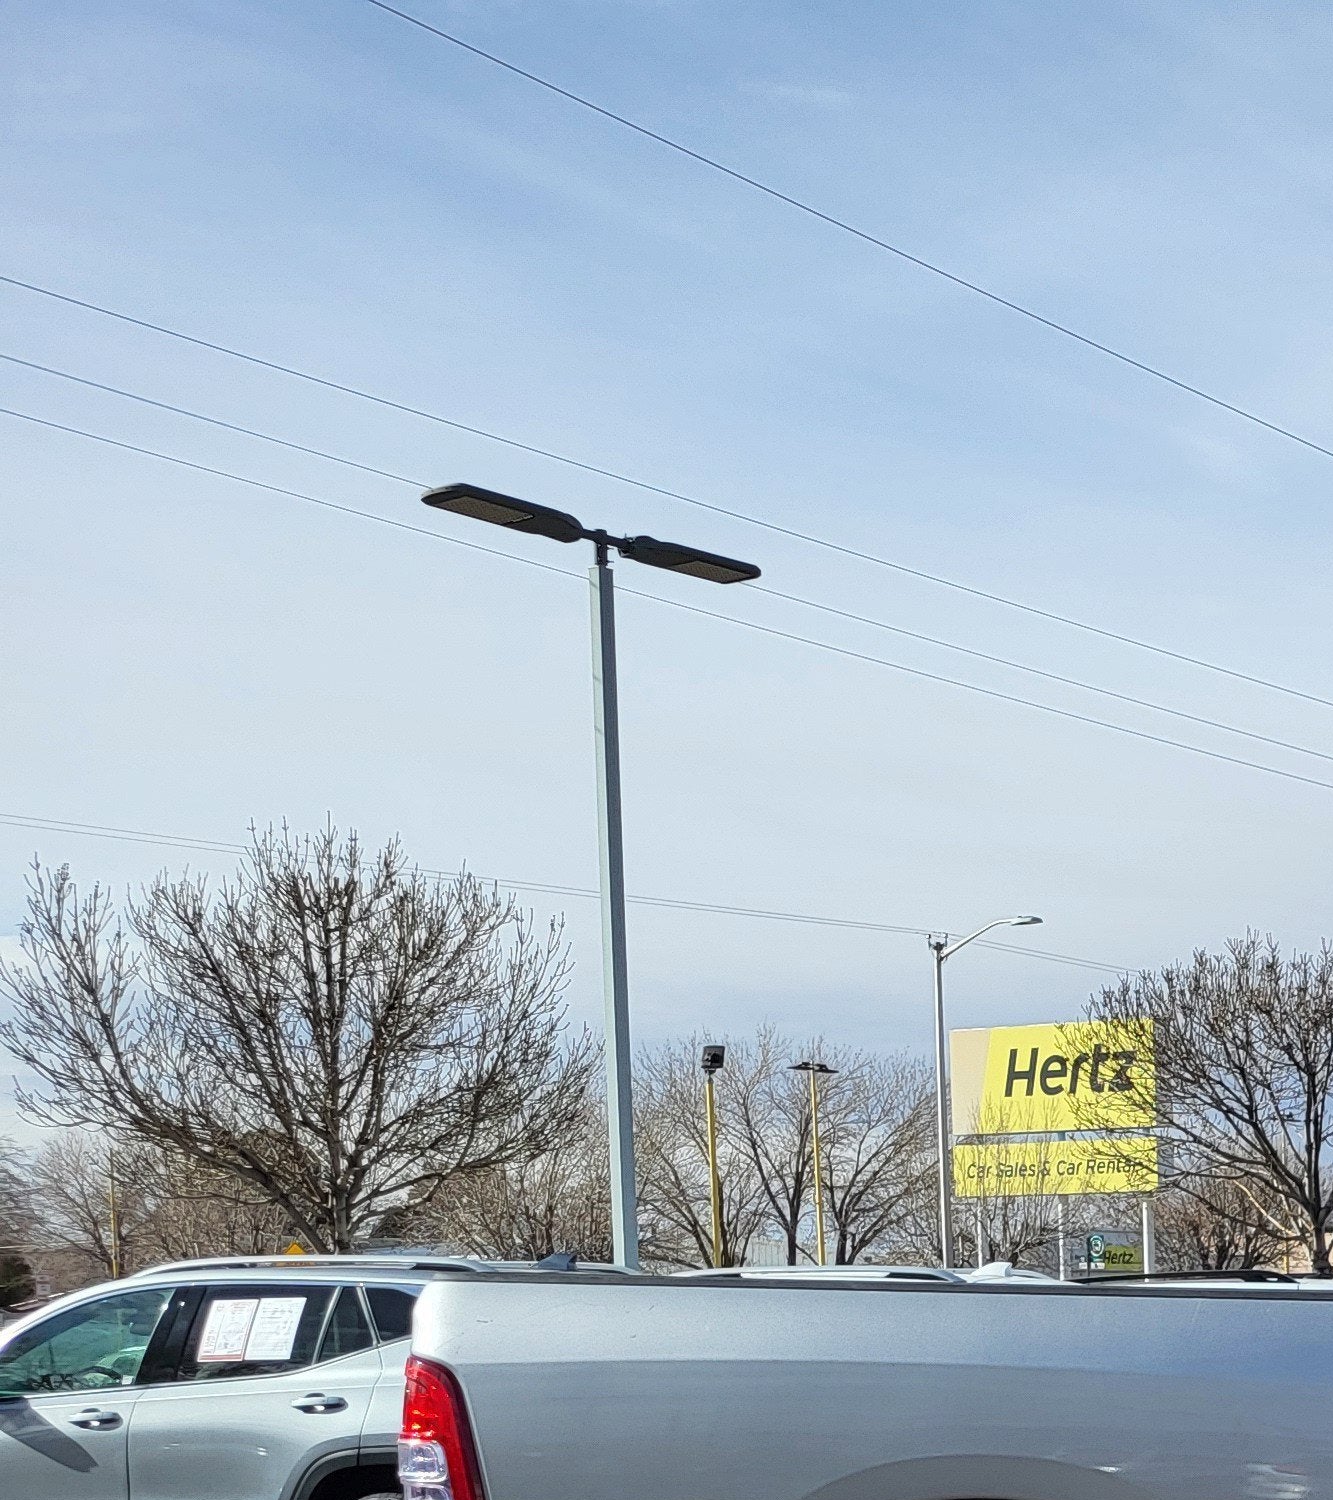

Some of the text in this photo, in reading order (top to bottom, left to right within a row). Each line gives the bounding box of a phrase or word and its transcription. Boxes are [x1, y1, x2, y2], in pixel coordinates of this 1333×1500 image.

[1004, 1044, 1136, 1097] Hertz
[967, 1161, 991, 1178] Car
[1056, 1160, 1082, 1176] Car
[1104, 1250, 1134, 1264] Hertz
